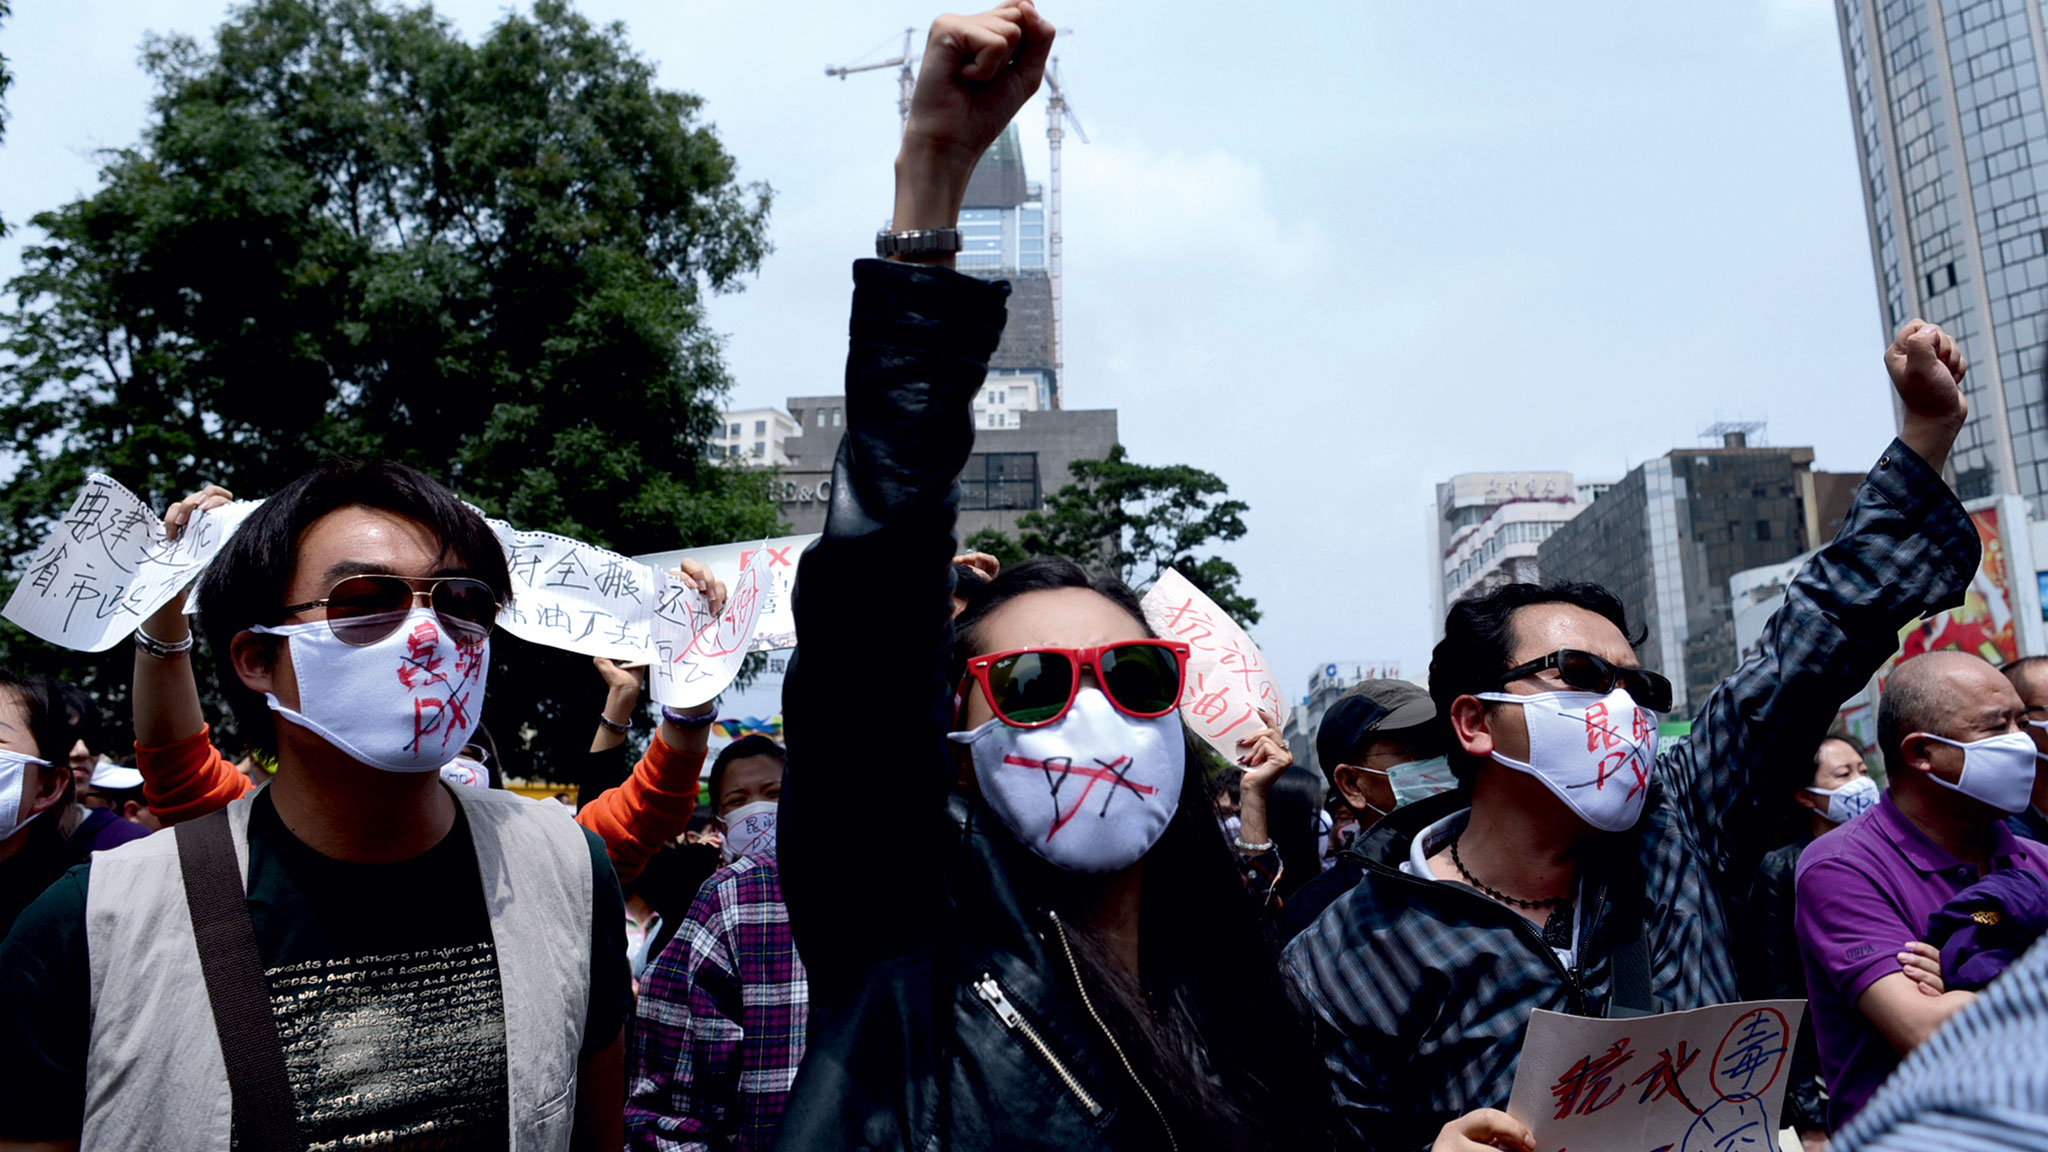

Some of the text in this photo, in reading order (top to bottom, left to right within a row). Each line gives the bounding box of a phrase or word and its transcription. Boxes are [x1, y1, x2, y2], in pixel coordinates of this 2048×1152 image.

[413, 691, 471, 758] PX
[1596, 751, 1650, 804] PX
[263, 960, 322, 976] eveals
